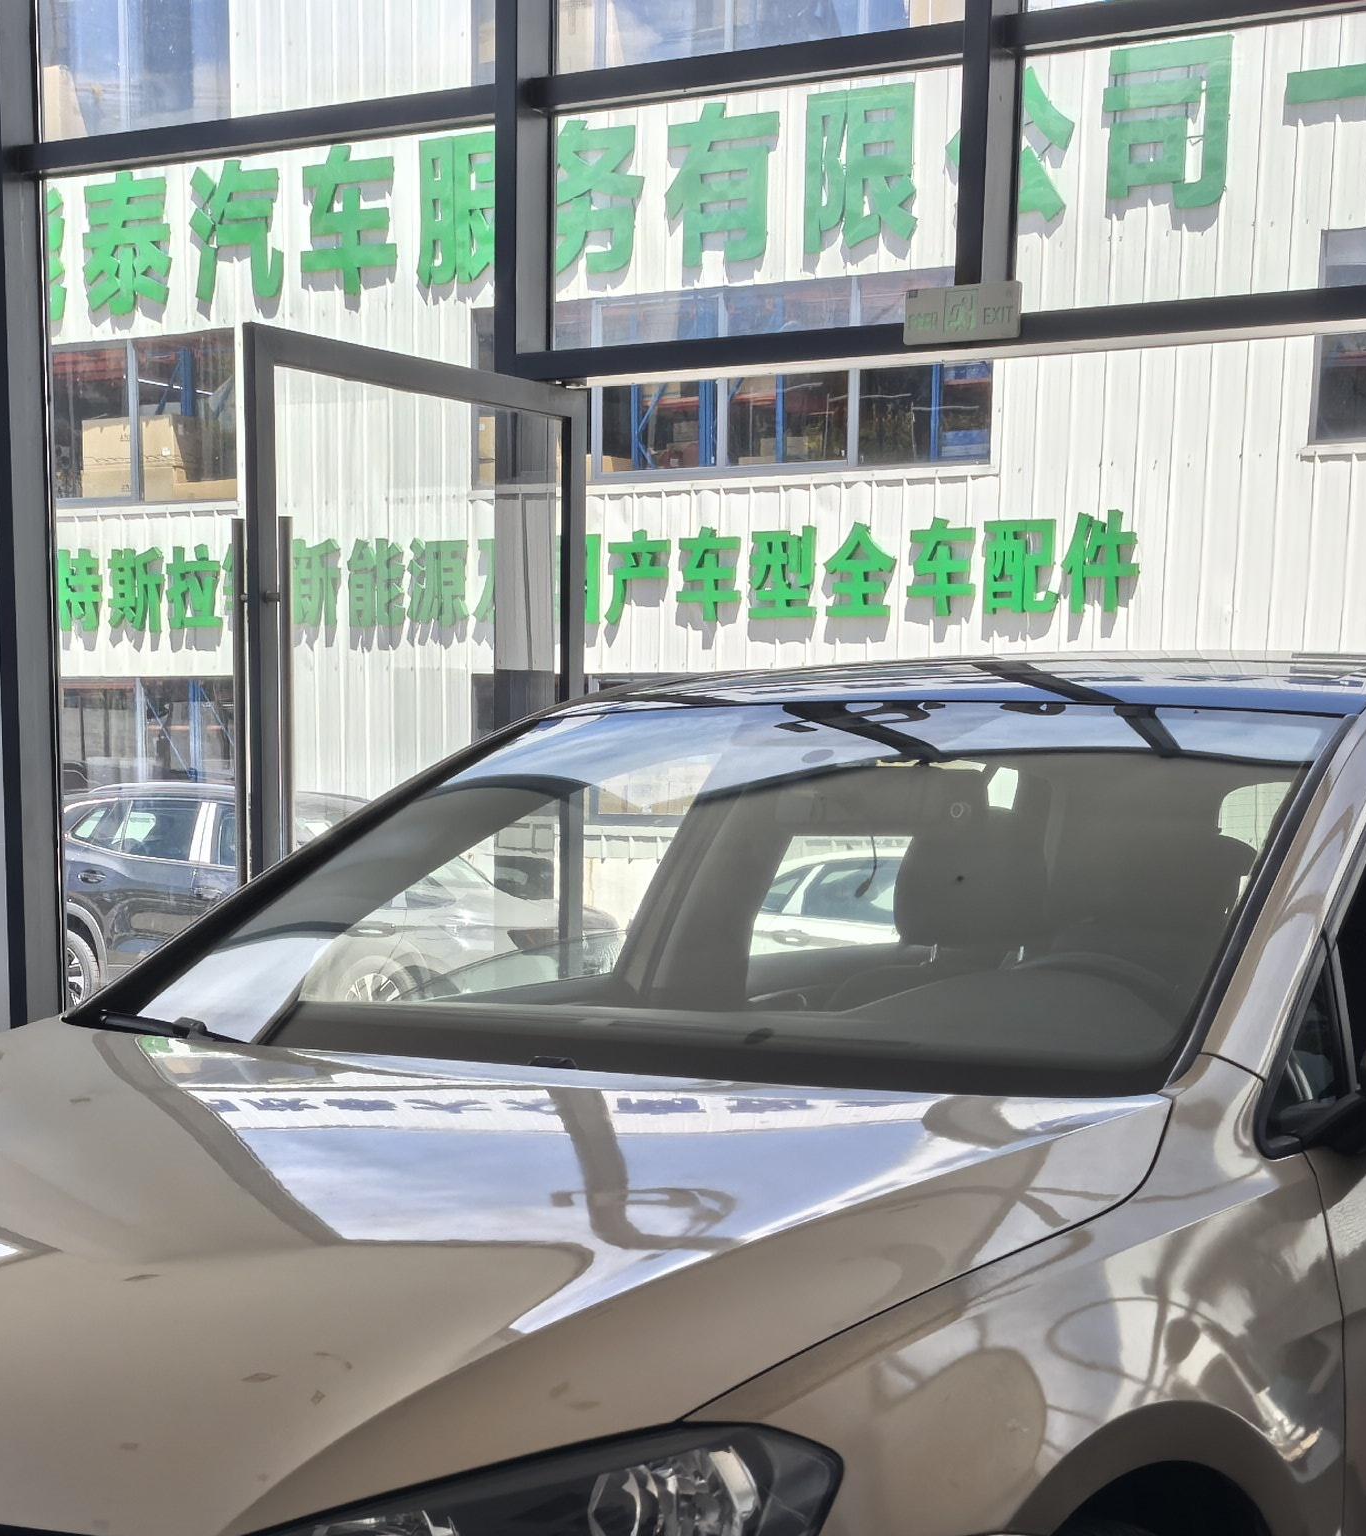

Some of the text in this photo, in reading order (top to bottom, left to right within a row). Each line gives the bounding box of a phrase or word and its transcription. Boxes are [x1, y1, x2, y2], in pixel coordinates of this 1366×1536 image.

[48, 34, 1234, 316] 泰汽车服务有限公司
[983, 305, 1014, 325] EXIT
[58, 510, 1140, 633] 特斯拉新能源产车型全车配件
